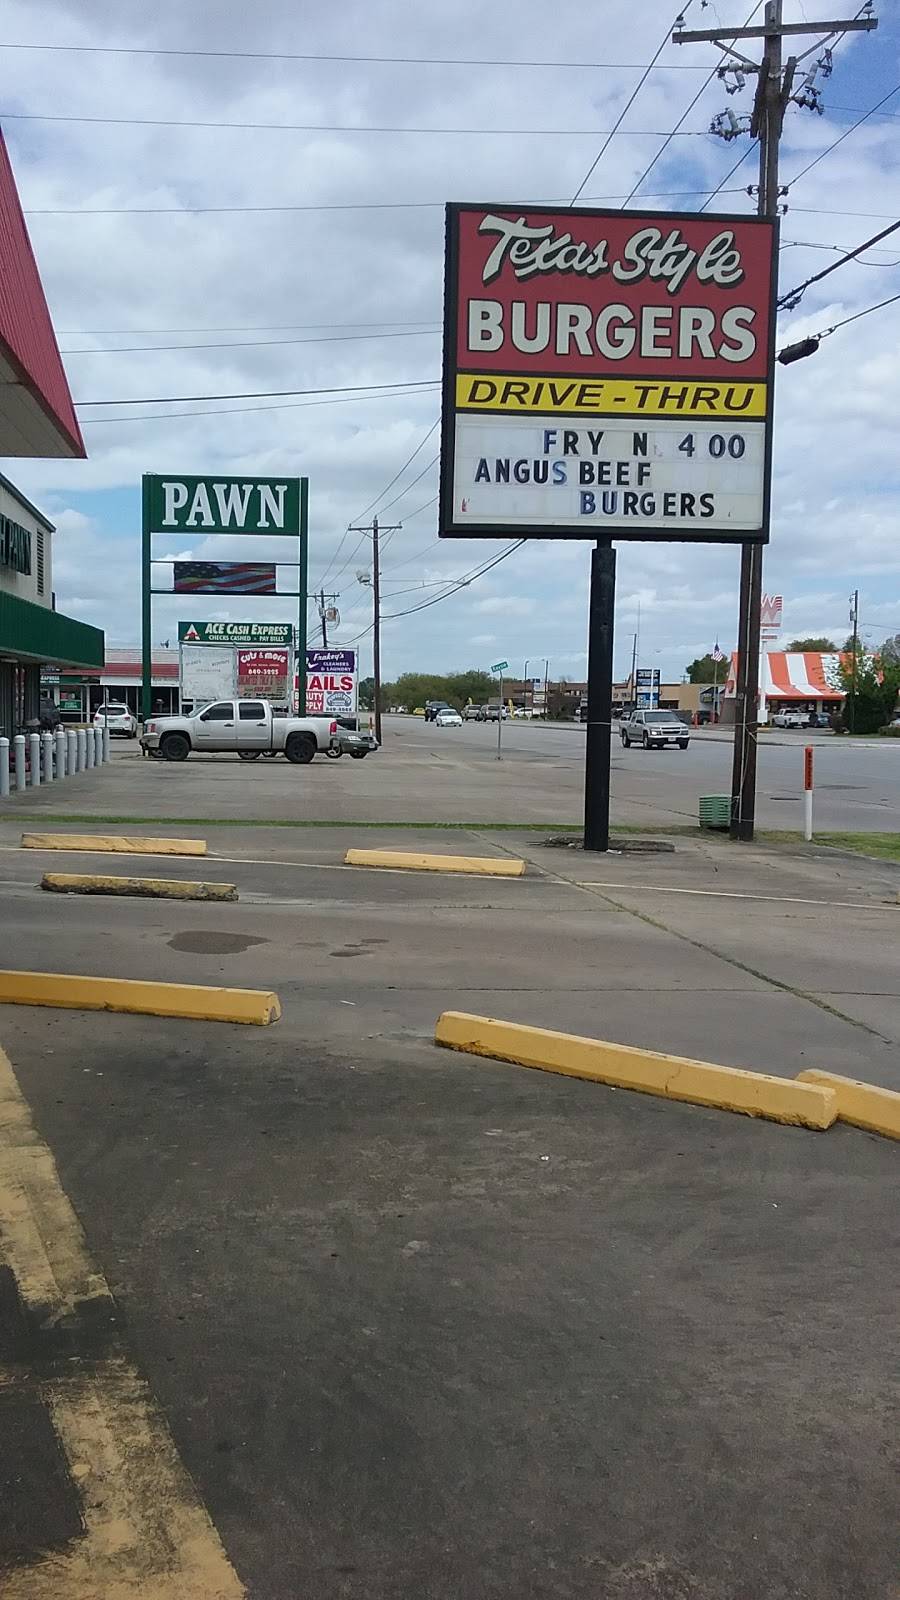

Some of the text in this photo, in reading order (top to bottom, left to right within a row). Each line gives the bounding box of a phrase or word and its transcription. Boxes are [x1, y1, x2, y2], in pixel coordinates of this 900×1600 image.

[478, 214, 744, 296] Texas Style
[467, 298, 757, 362] BURGERS
[543, 430, 746, 458] FRY N 4 00
[475, 458, 651, 486] ANGUS BEEF
[162, 482, 288, 528] PAWN
[580, 490, 715, 517] BURGERS
[205, 623, 288, 636] ACE CASH EXPRESS
